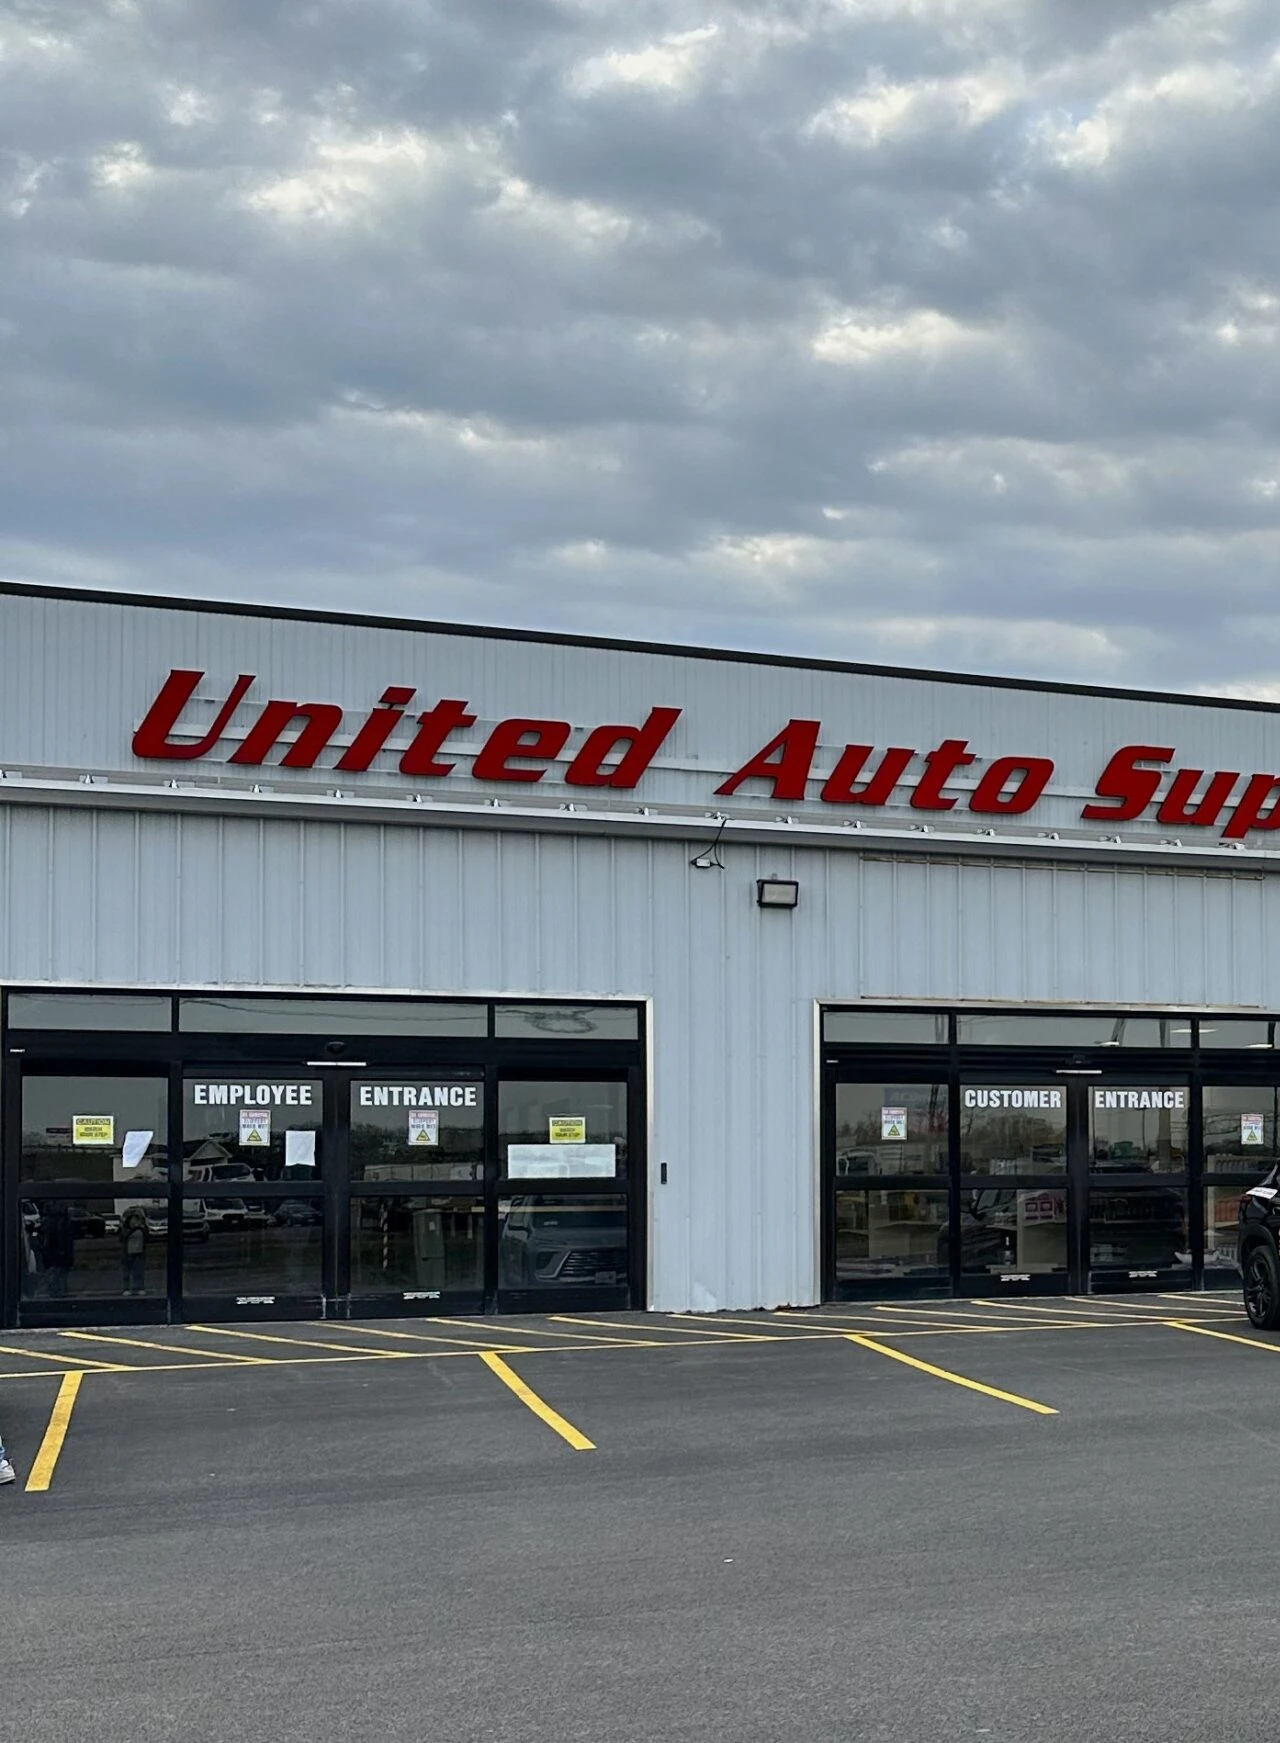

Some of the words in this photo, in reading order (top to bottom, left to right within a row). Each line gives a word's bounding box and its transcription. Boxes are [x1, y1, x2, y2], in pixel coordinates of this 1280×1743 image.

[132, 669, 682, 788] United
[714, 719, 1054, 814] Auto
[194, 1084, 312, 1105] EMPLOYEE
[360, 1086, 477, 1106] ENTRANCE
[964, 1089, 1061, 1108] CUSTOMER
[1095, 1091, 1184, 1109] ENTRANCE
[76, 1118, 111, 1126] CAUTION
